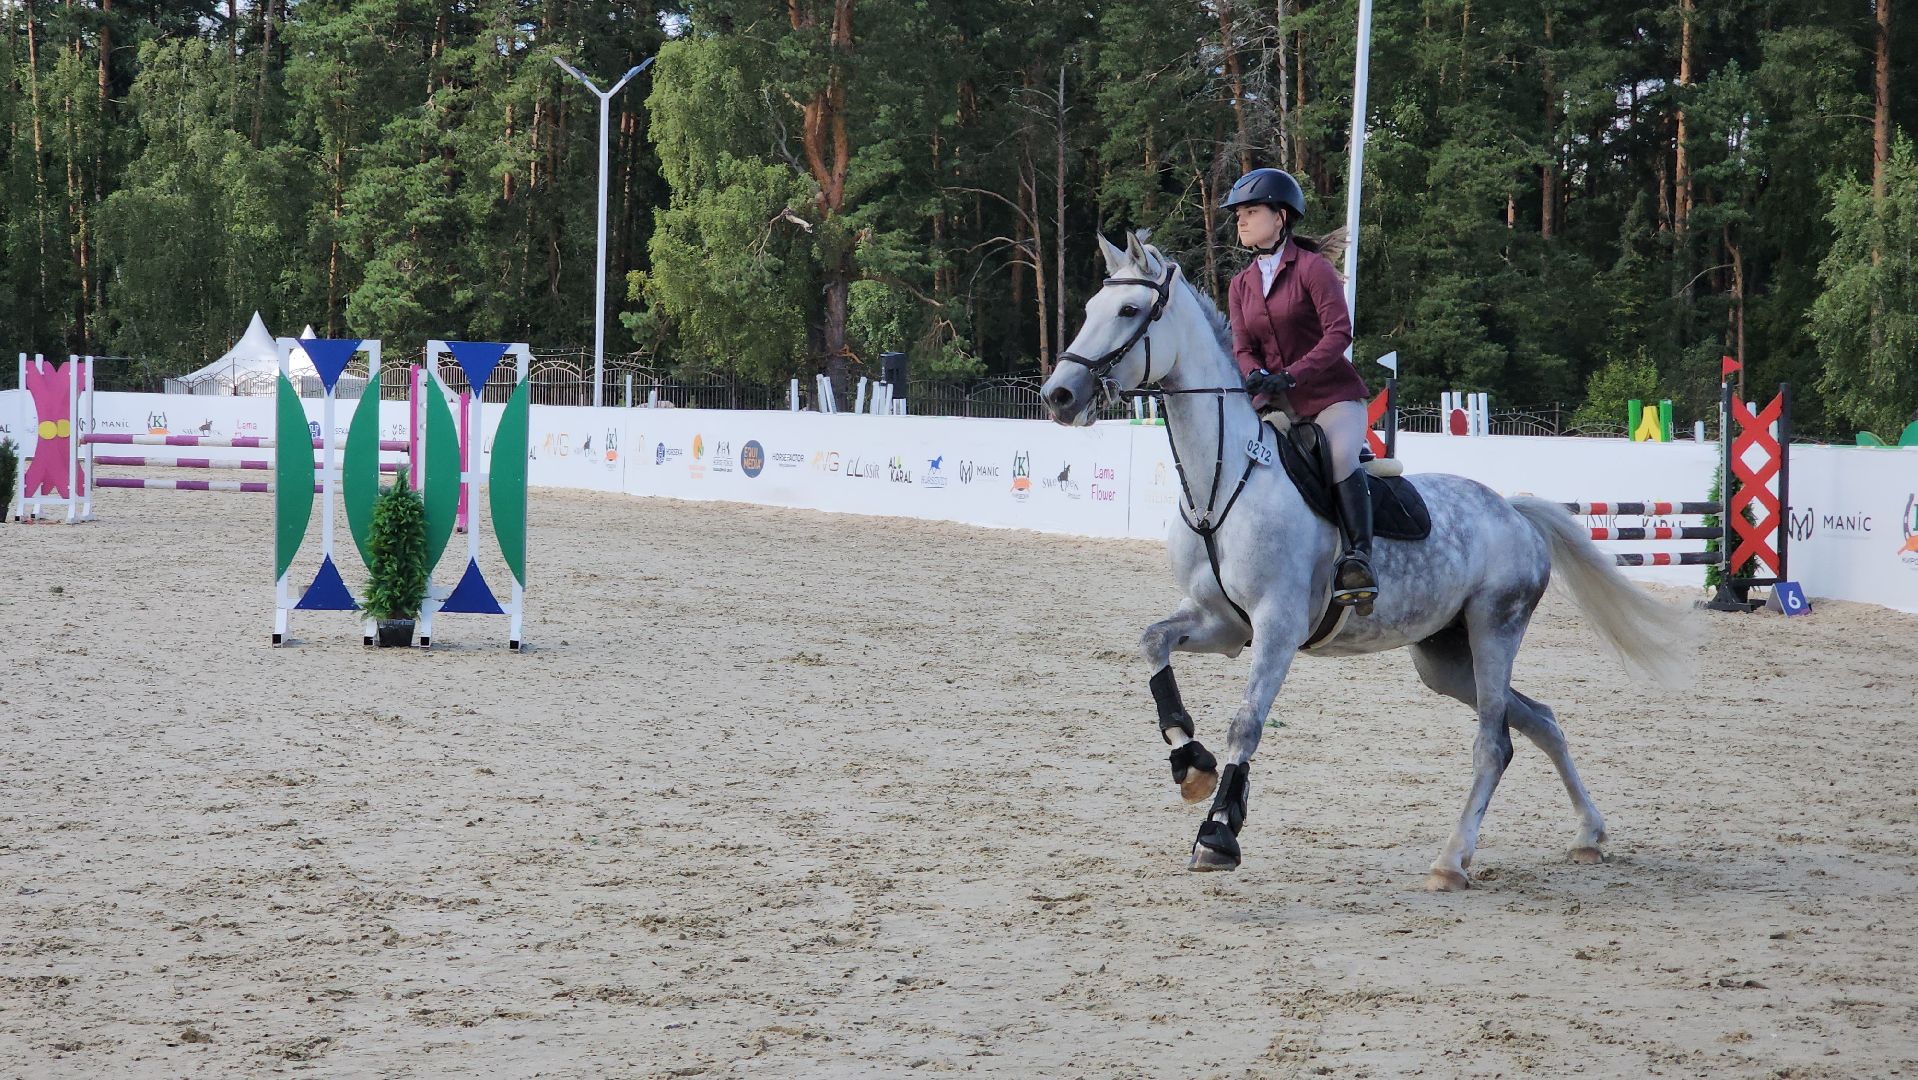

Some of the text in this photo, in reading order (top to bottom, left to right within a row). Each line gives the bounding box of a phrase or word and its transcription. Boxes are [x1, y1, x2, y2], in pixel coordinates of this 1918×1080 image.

[1247, 440, 1272, 463] 0272
[890, 470, 912, 484] KARAL
[1093, 462, 1116, 481] Lama
[1090, 483, 1117, 502] Flower
[1788, 590, 1801, 610] 6
